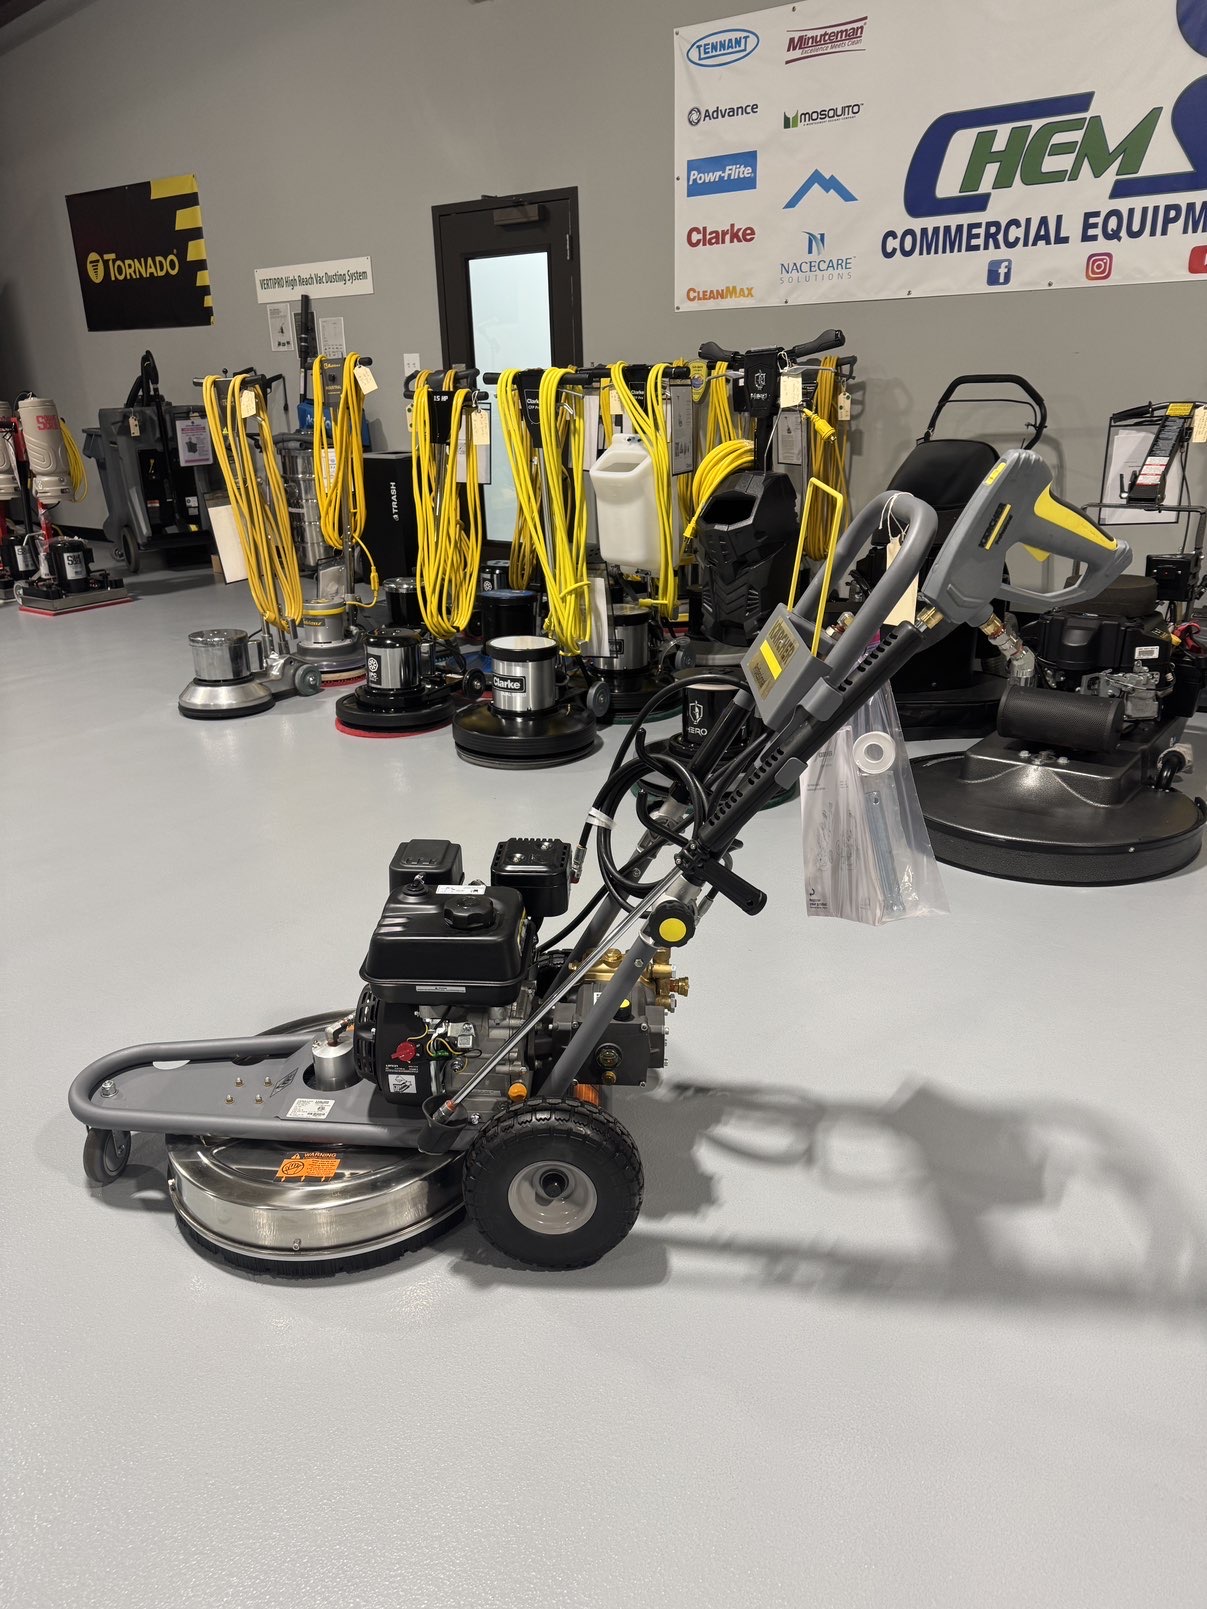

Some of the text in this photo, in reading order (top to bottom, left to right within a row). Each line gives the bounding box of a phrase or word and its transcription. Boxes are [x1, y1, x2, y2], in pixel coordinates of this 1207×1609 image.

[696, 35, 750, 61] TENNANT
[786, 25, 865, 53] Minuteman
[829, 41, 846, 50] Meets
[703, 103, 759, 122] Advance
[688, 164, 753, 185] Powr-Flite
[686, 223, 756, 248] Clarke
[881, 214, 1070, 259] COMMERCIAL
[103, 253, 180, 281] TORNADO
[780, 257, 853, 275] NACECARE
[259, 269, 368, 290] VERTIPRO High Reach Vac Dusting System
[780, 272, 853, 284] SOLUTIONS
[390, 482, 399, 517] TRASH
[492, 676, 521, 690] Clarke
